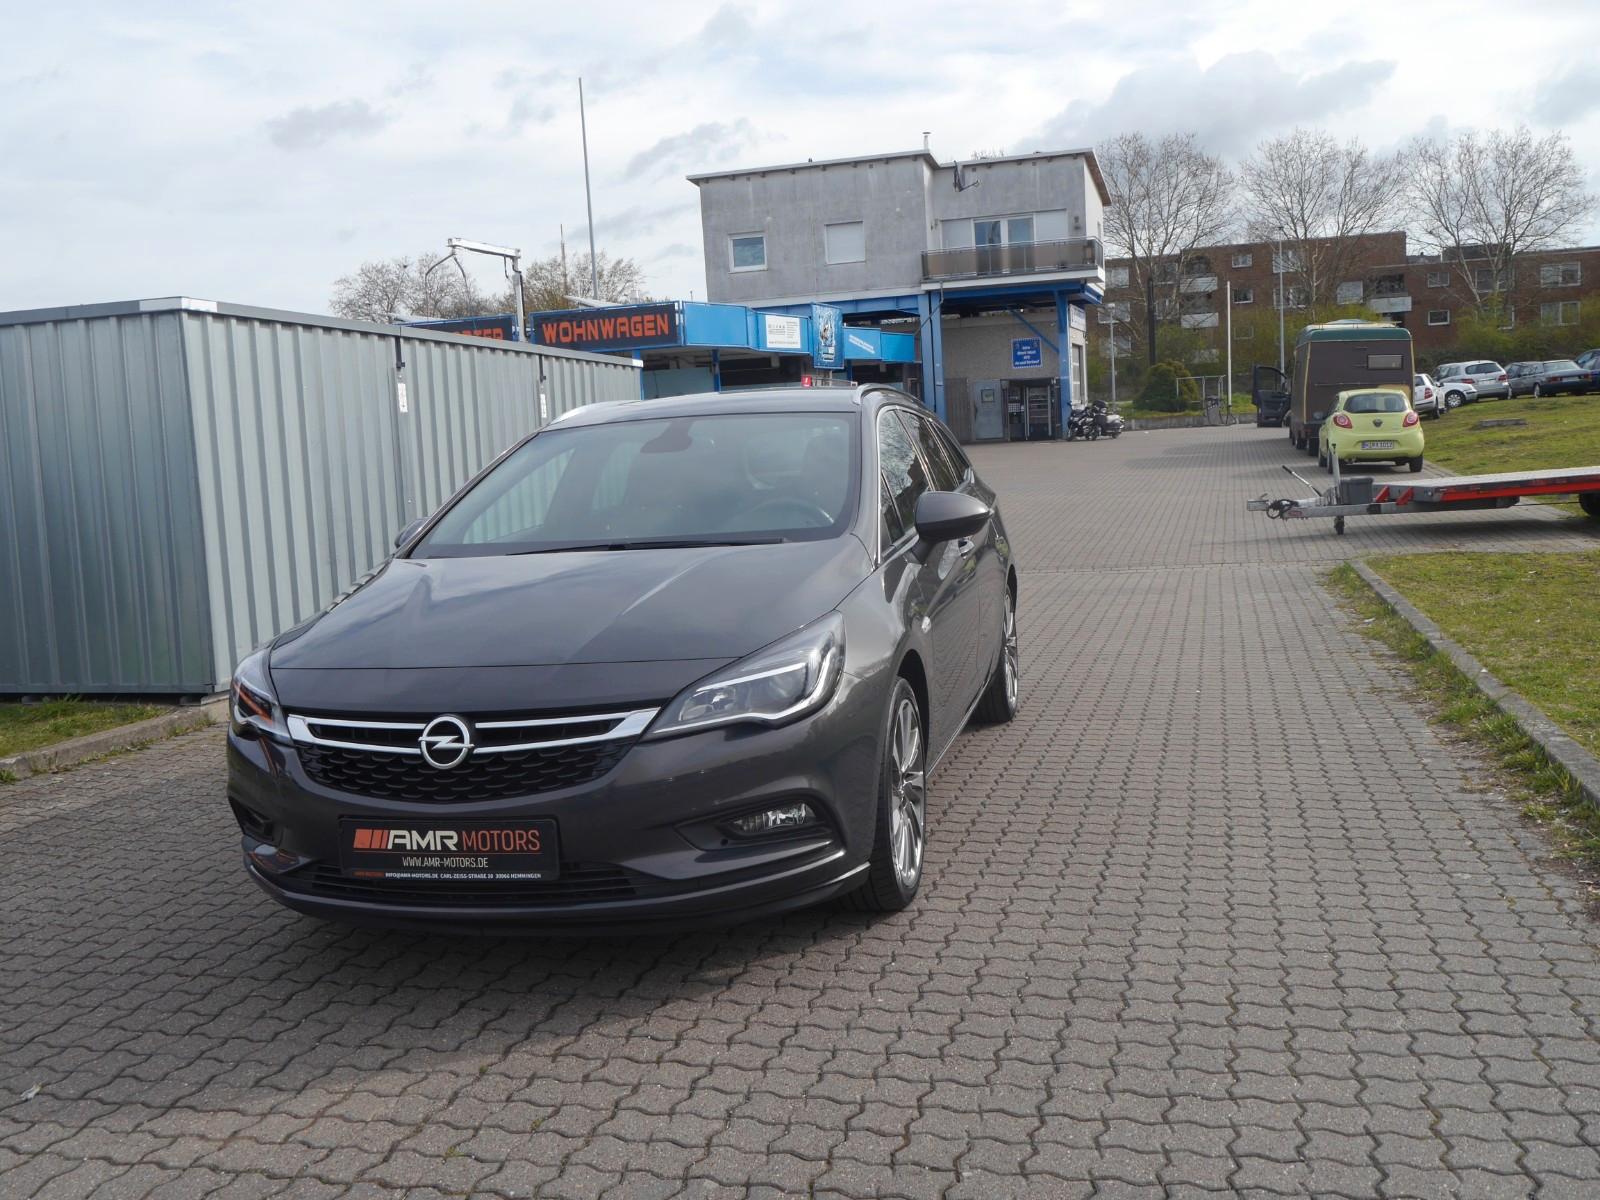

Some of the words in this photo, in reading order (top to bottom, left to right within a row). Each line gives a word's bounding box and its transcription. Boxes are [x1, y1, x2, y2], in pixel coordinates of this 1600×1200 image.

[542, 313, 669, 344] WOHNWAGEN
[387, 829, 458, 851] AMR
[462, 829, 540, 851] MOTORS
[402, 856, 489, 868] WWW.AMR-MOTORS.DE
